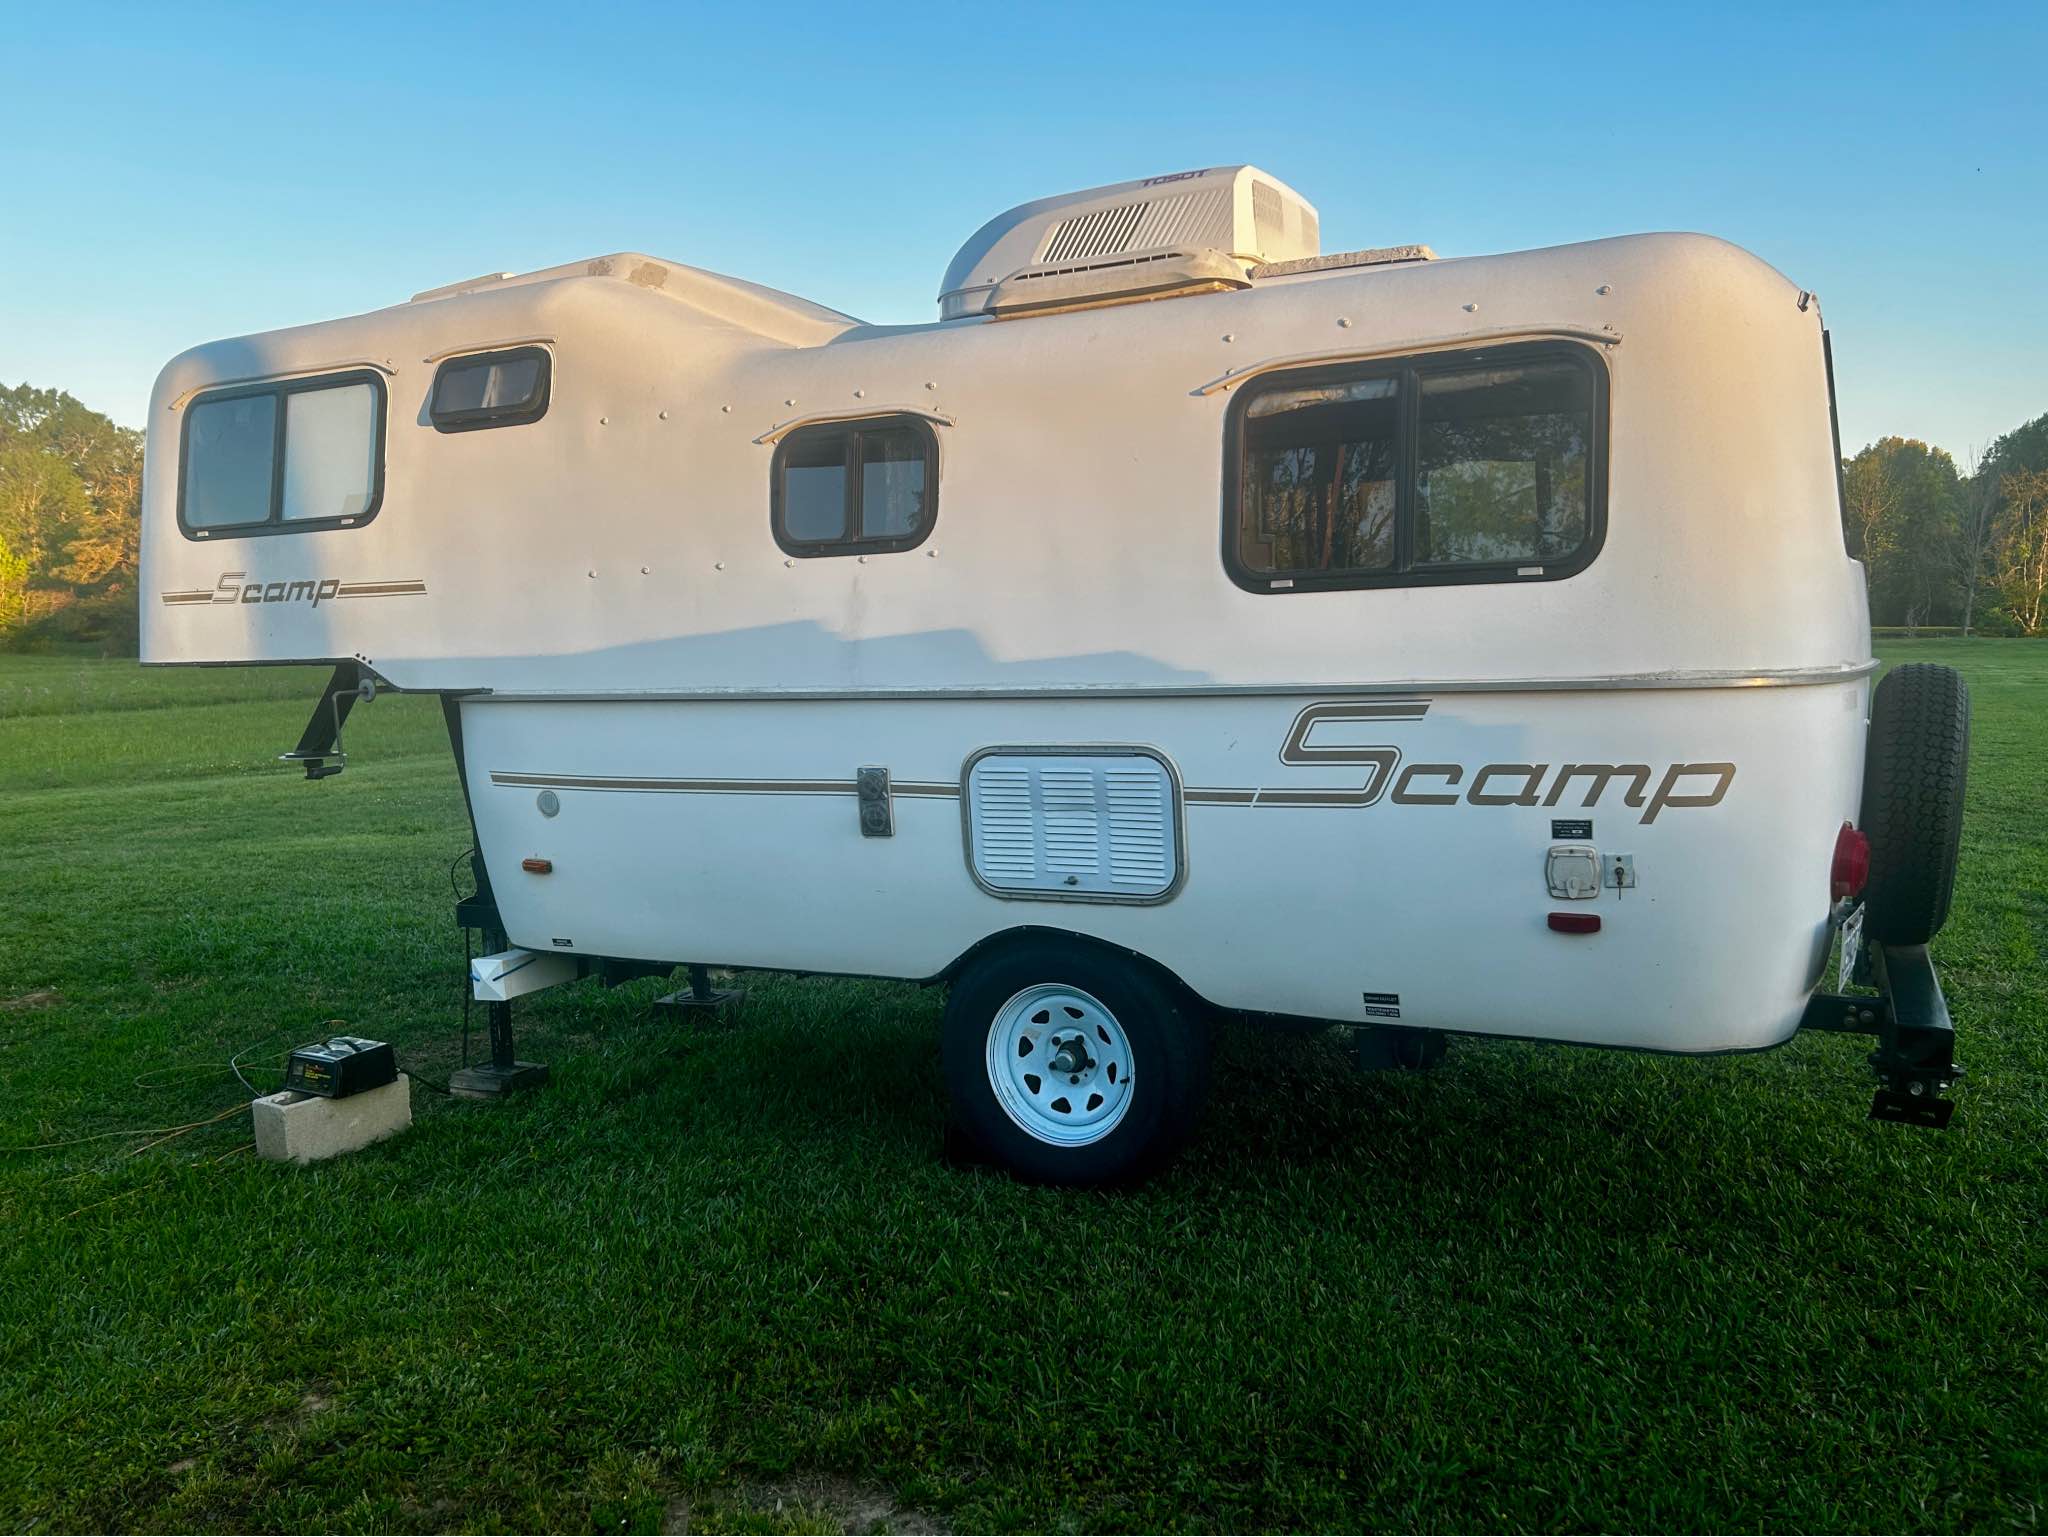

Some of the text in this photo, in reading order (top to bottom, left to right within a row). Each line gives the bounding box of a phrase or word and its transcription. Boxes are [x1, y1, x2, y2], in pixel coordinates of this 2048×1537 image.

[1141, 168, 1211, 188] TOSOT
[211, 571, 340, 609] Scamp
[1254, 698, 1737, 825] Scamp
